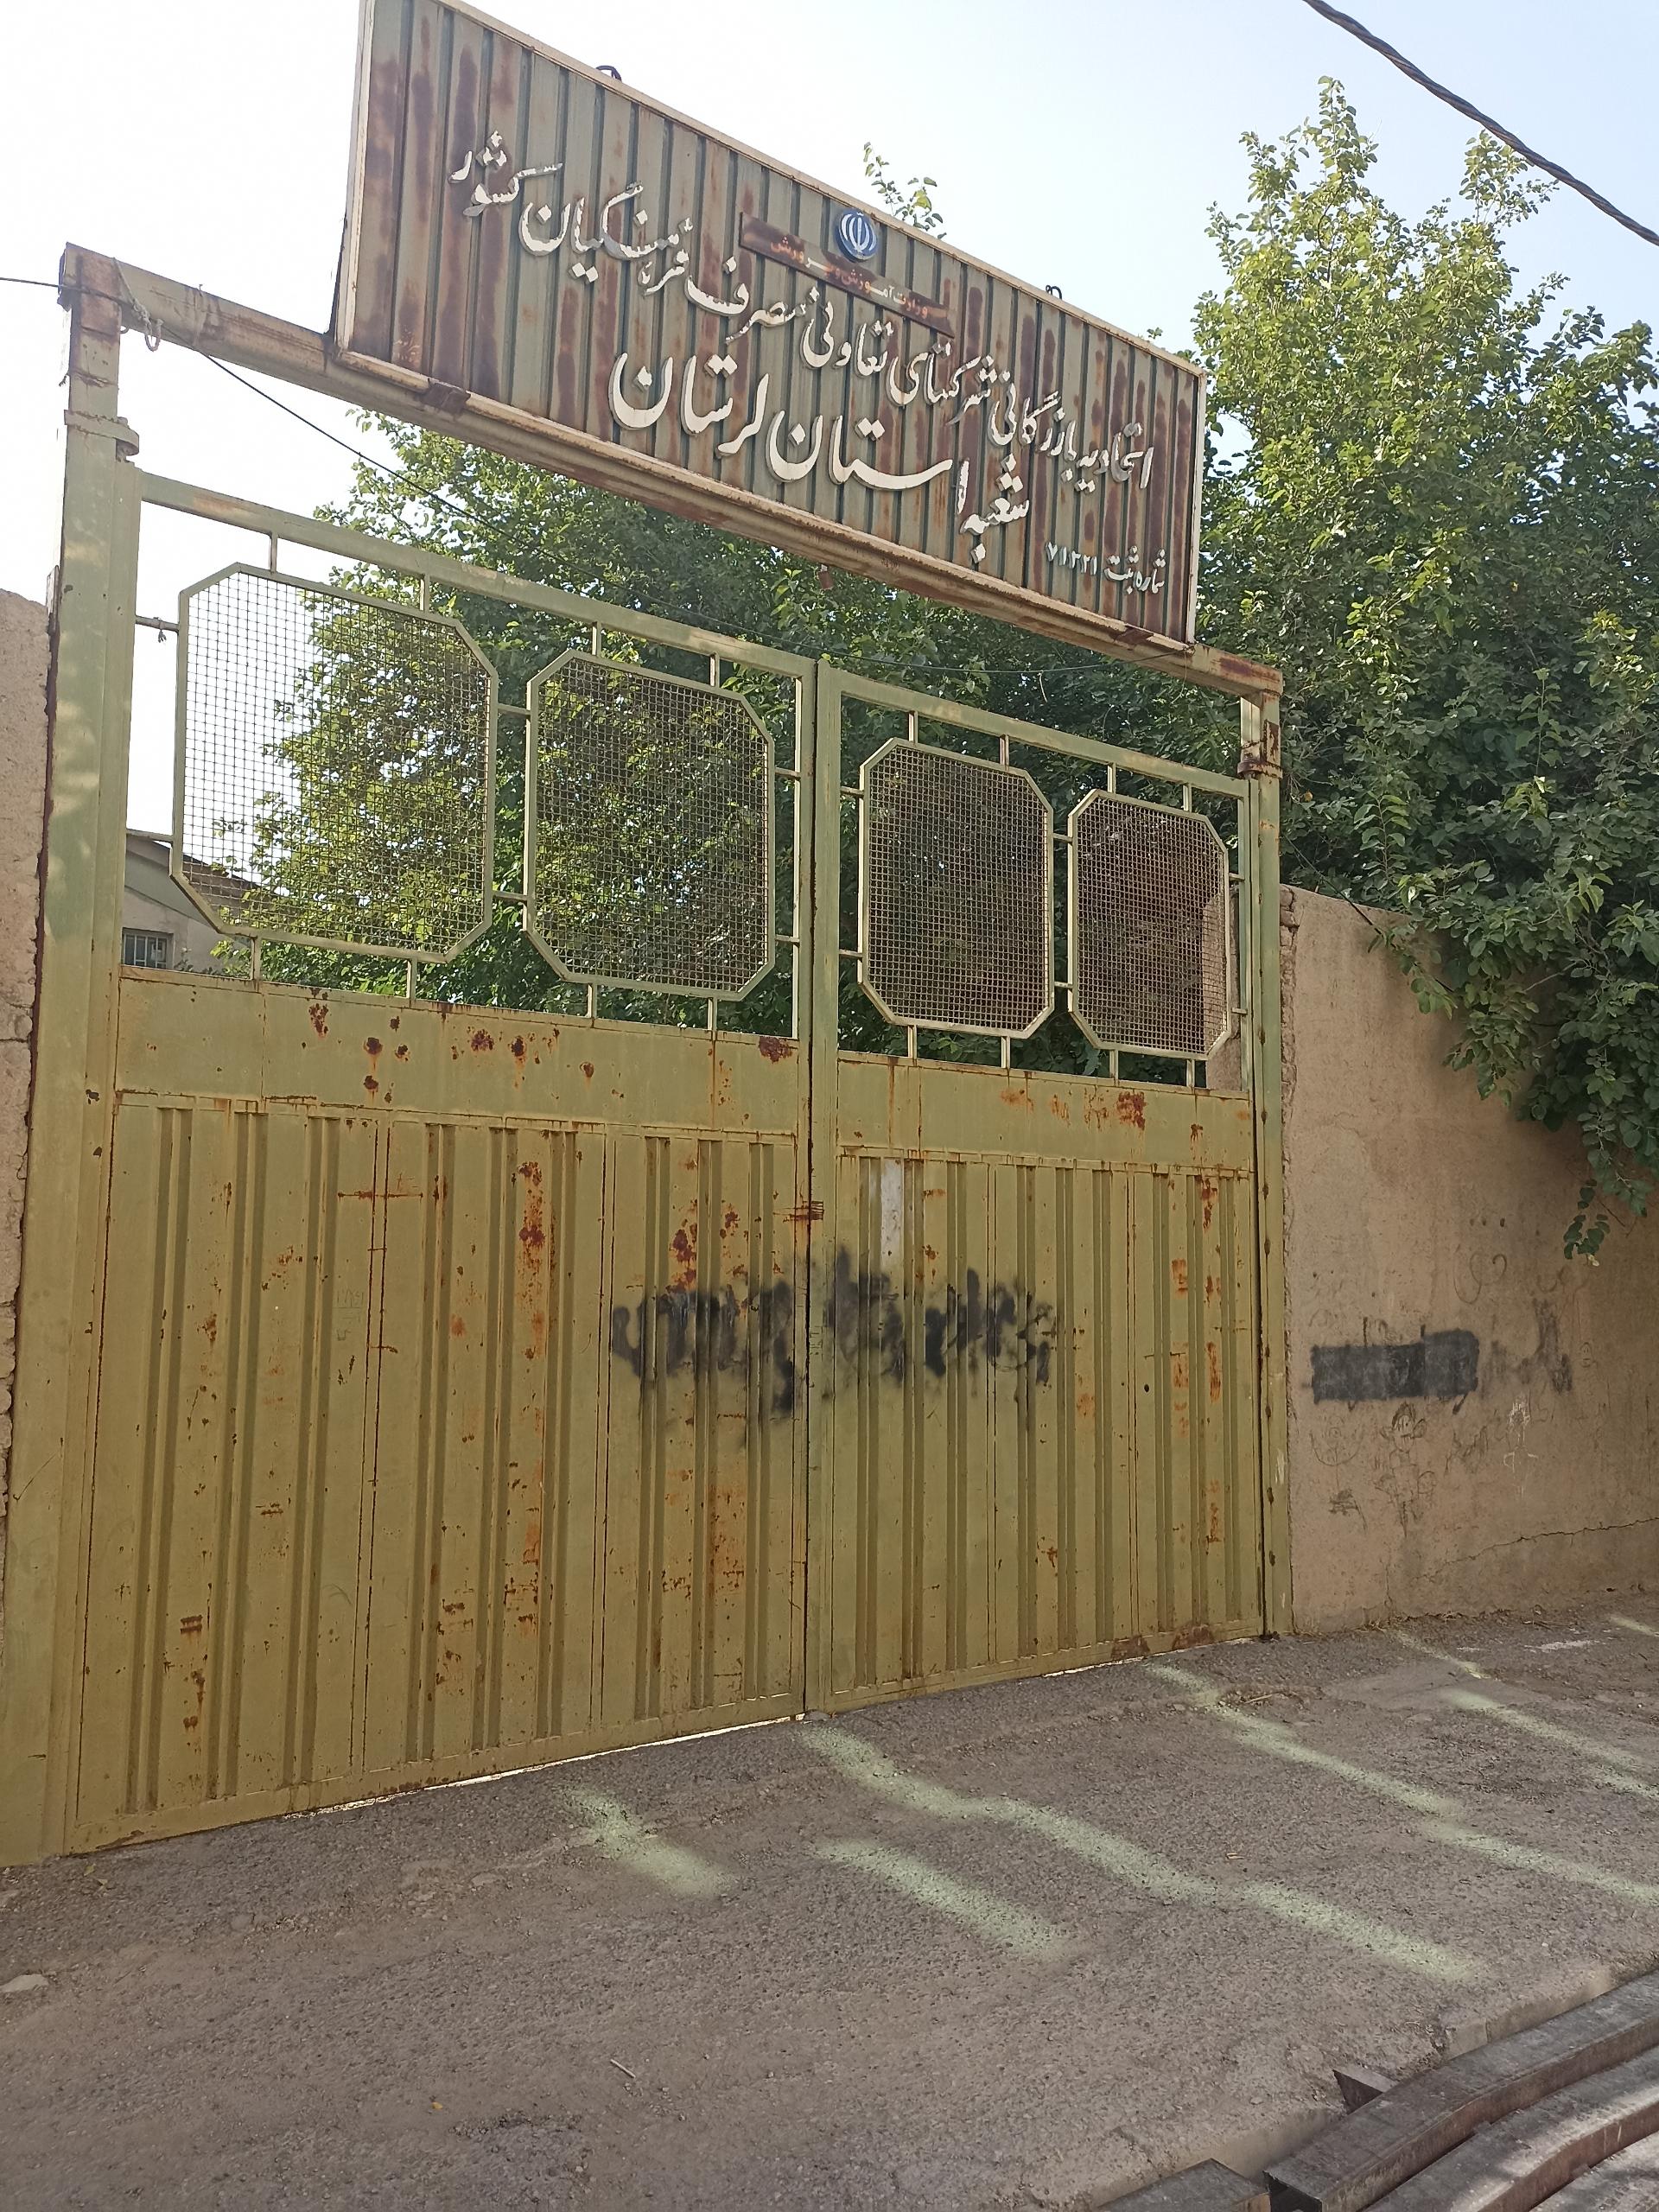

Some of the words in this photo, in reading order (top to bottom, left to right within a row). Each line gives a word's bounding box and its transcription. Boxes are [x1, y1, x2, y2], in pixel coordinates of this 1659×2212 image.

[448, 130, 563, 217] کشور
[519, 181, 694, 298] فرهنگیان
[685, 257, 807, 345] مصرف
[800, 286, 894, 378] تعاونی
[894, 291, 929, 318] وزارت
[609, 351, 769, 458] لرستان
[988, 370, 1077, 482] بازرگانی
[766, 410, 969, 515] استان
[1075, 422, 1154, 494] اتحادیه
[959, 453, 1029, 563] شعبه
[1103, 544, 1140, 595] ثبت
[1133, 549, 1166, 594] شماره
